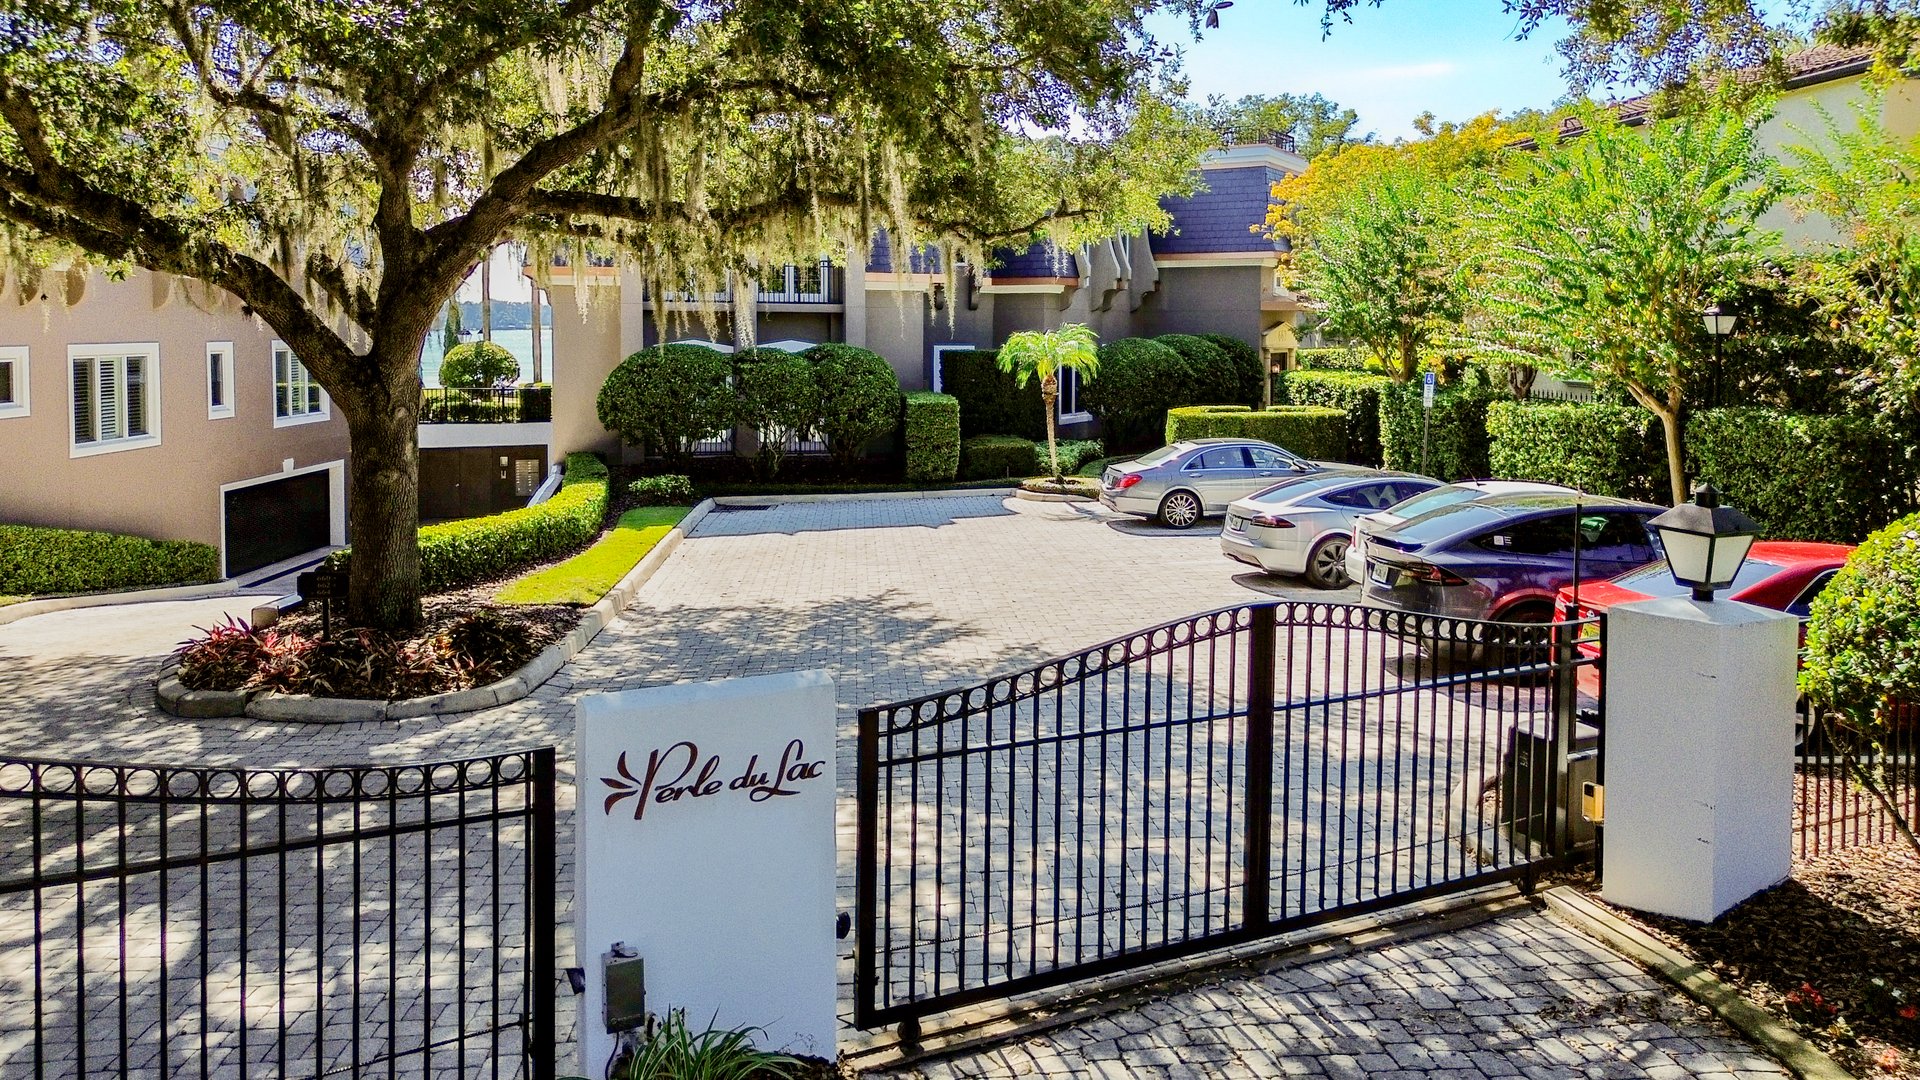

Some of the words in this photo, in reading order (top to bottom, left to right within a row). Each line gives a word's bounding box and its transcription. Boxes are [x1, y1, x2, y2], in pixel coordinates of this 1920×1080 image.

[634, 741, 723, 820] Perle
[729, 754, 770, 791] du
[750, 738, 826, 802] Lac
